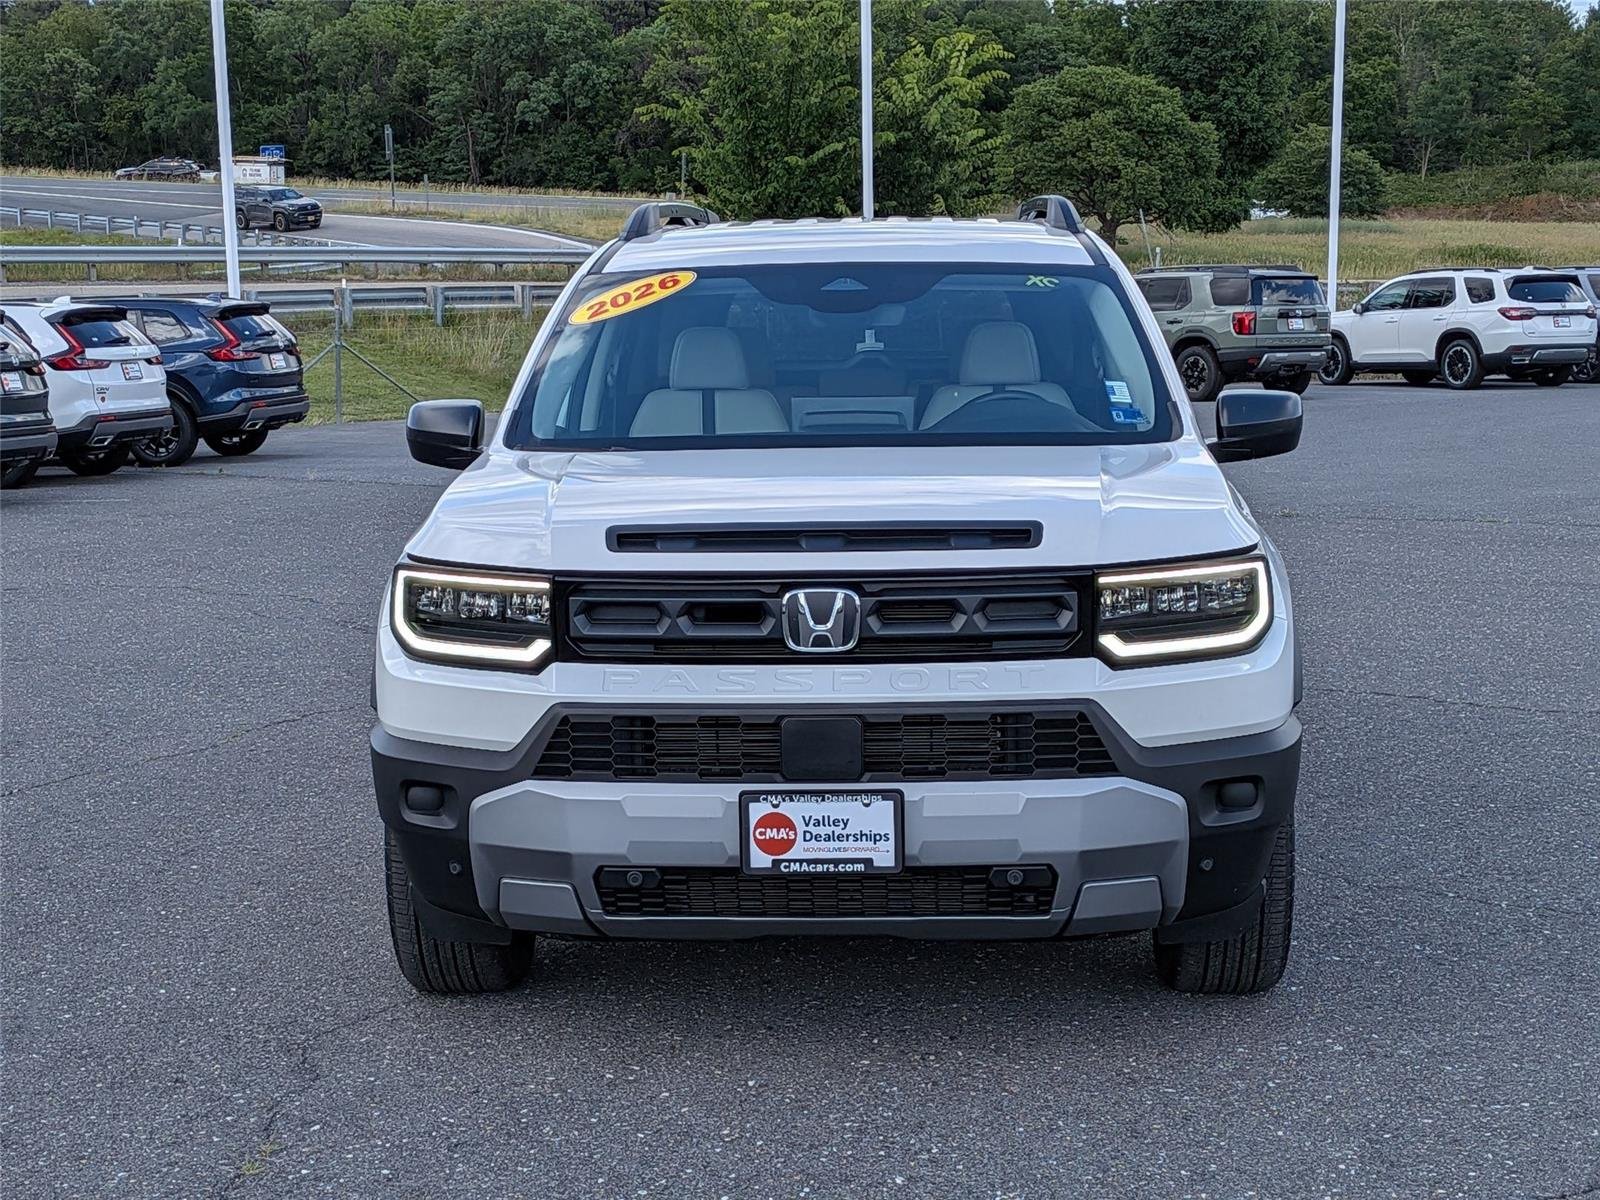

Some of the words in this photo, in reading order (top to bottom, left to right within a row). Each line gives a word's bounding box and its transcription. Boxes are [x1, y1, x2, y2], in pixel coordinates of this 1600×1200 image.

[586, 274, 681, 320] 2026
[602, 666, 1045, 693] PASSPORT
[792, 794, 823, 803] Valley
[801, 815, 850, 830] Valley
[755, 828, 795, 840] CMA's
[802, 830, 890, 845] Dealerships
[780, 862, 865, 873] CMAcars.com
